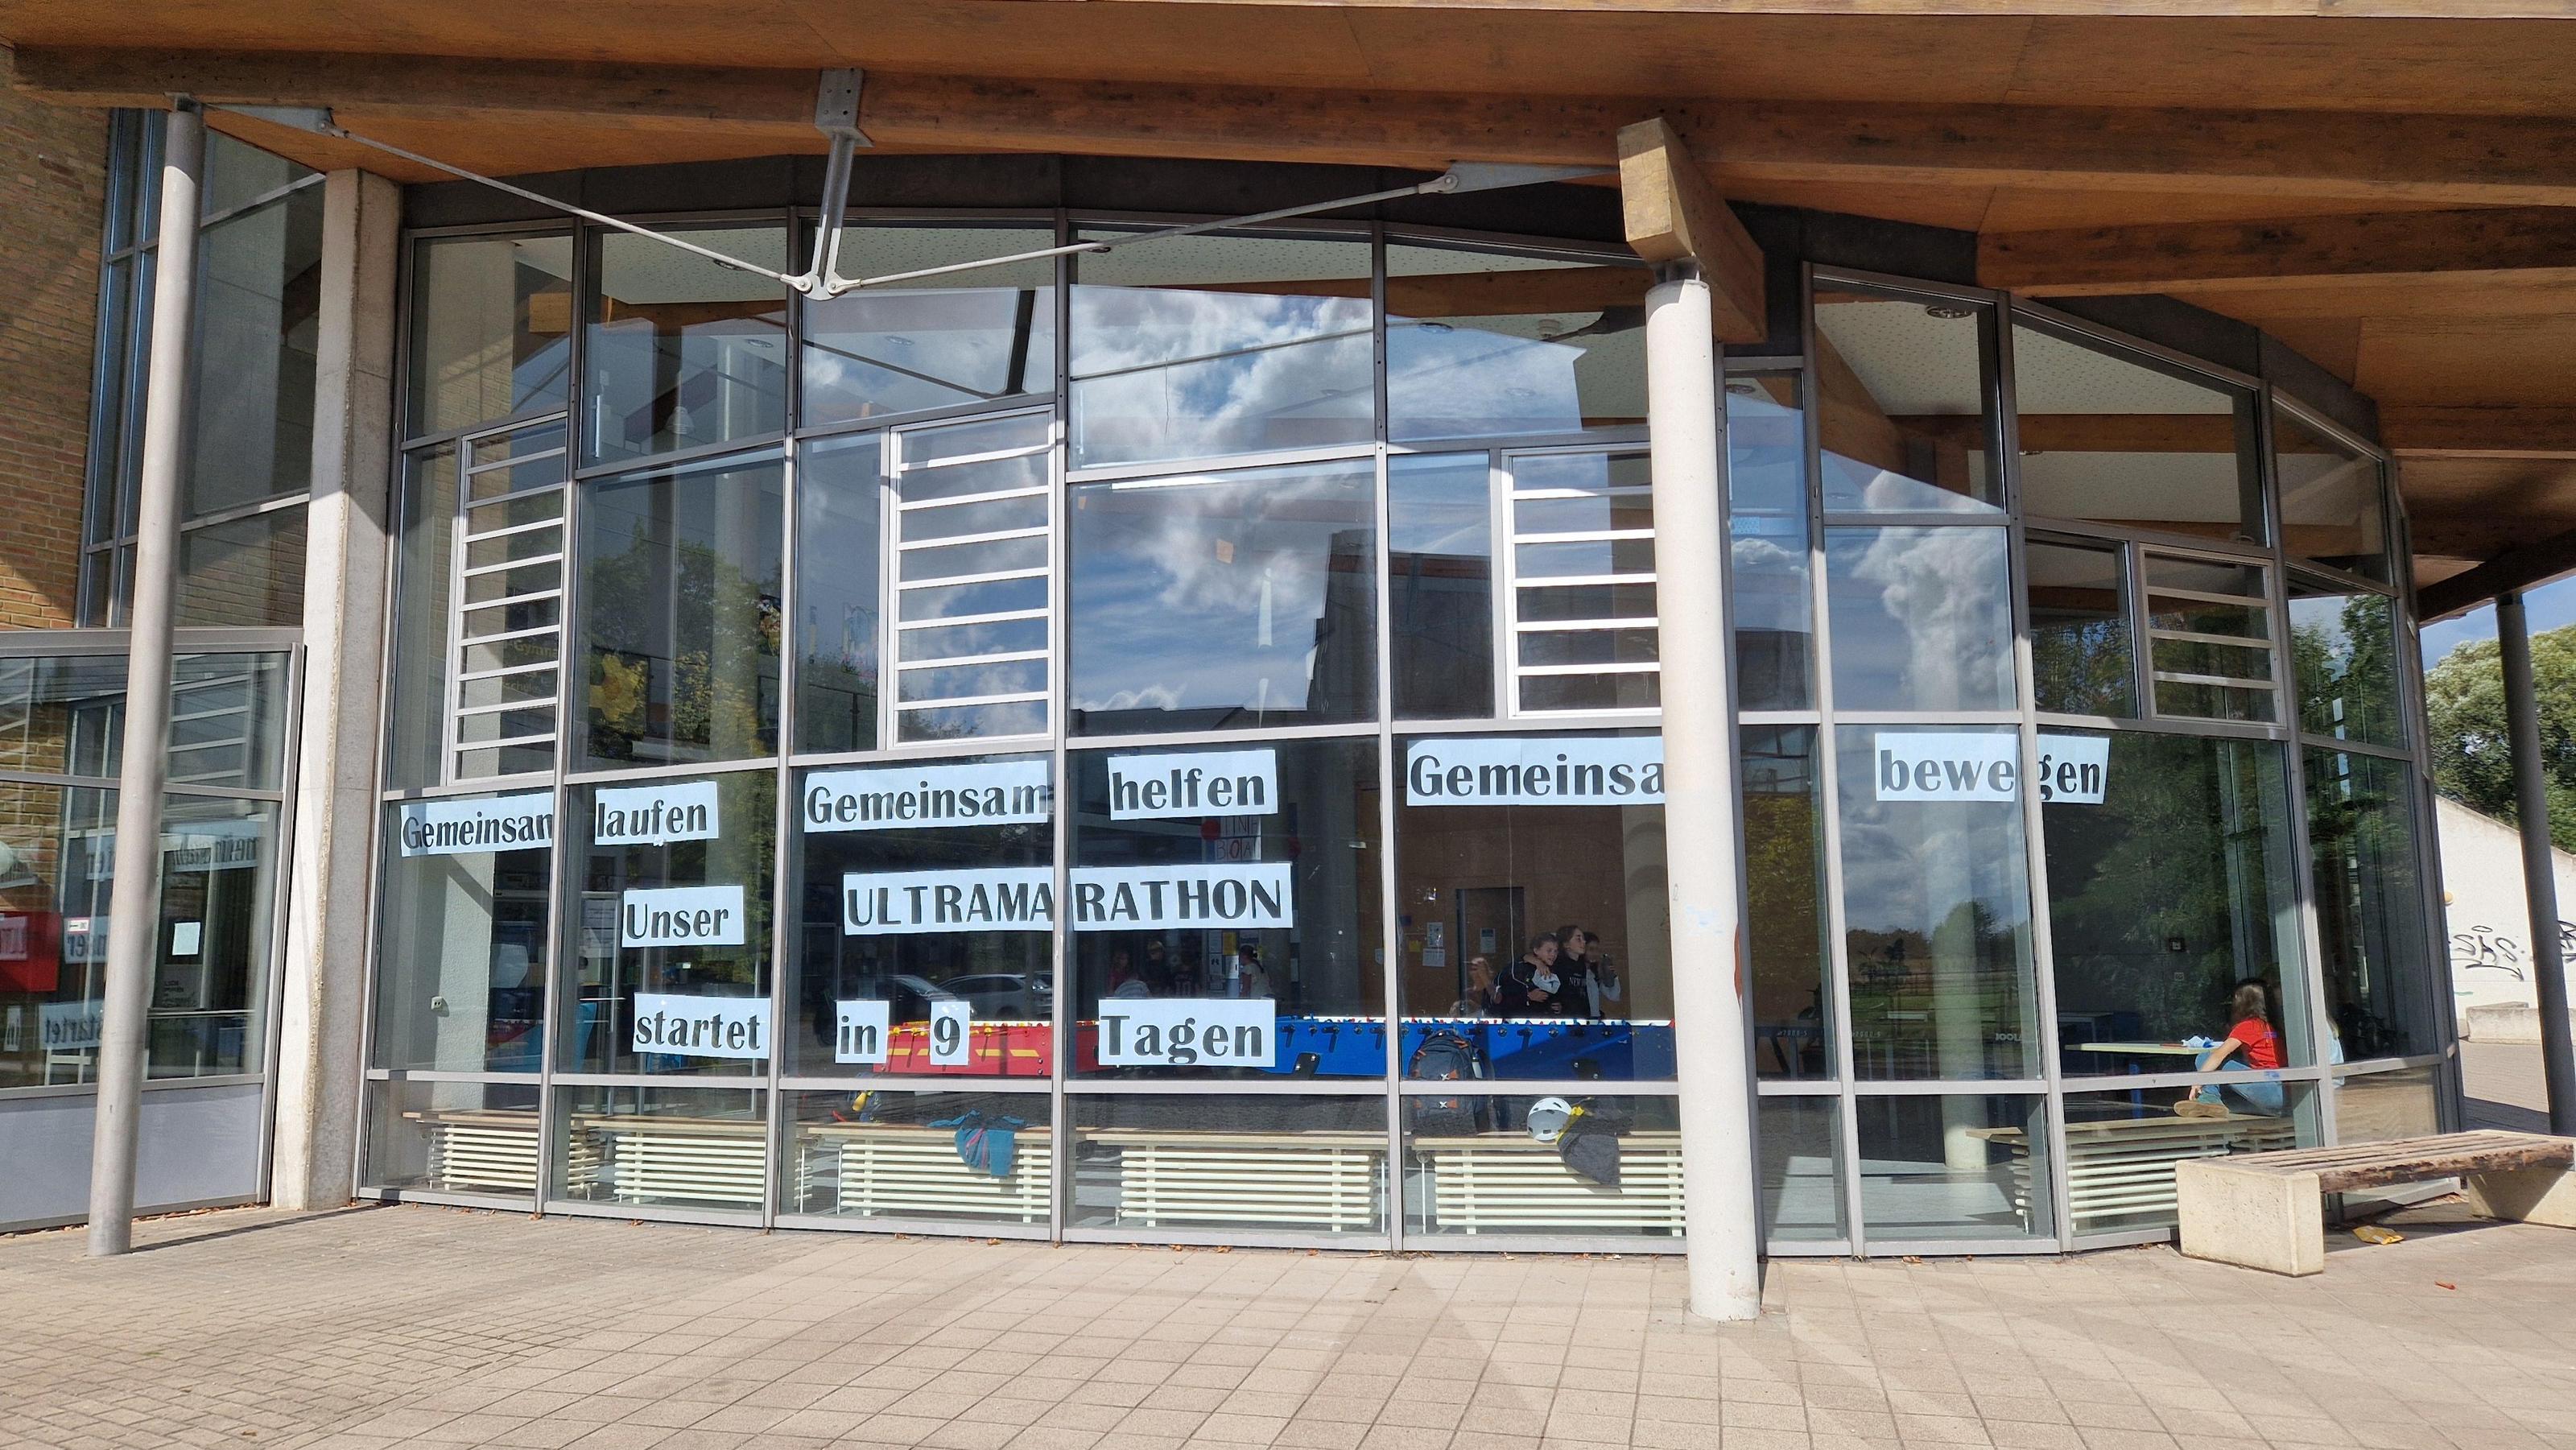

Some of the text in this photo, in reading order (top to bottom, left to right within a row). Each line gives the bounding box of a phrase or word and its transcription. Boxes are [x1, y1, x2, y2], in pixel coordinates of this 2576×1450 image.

[597, 799, 708, 837] laufen
[807, 780, 1047, 824] Gemeinsam
[1112, 767, 1265, 811] helfen
[1410, 754, 1665, 797] Gemeinsa
[625, 903, 729, 940] Unser
[635, 1010, 1262, 1065] startet in 9 Tagen
